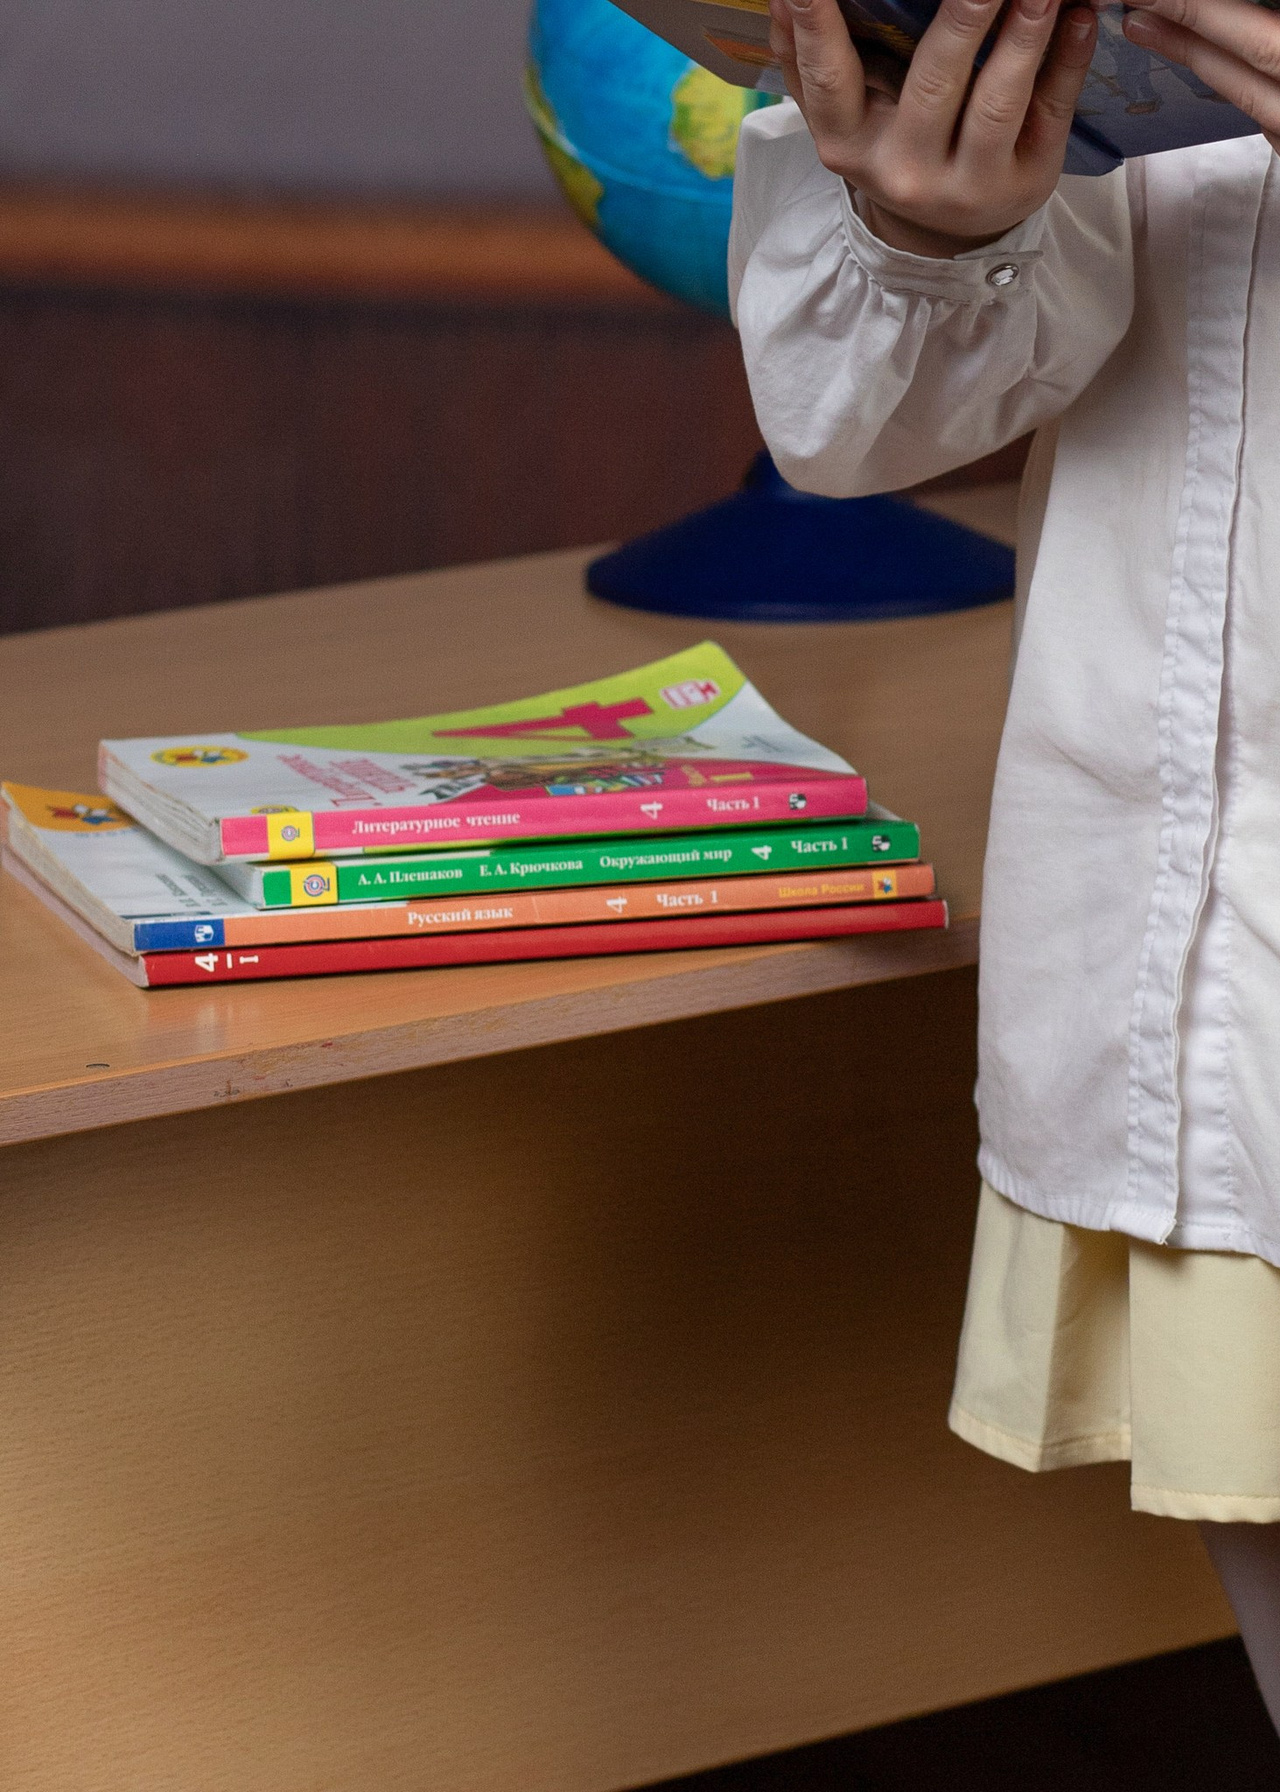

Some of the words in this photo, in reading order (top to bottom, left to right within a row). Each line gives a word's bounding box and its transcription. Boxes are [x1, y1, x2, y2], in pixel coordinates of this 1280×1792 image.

[352, 815, 461, 835] Литературное
[466, 812, 520, 827] чтение
[640, 801, 663, 820] 4
[706, 797, 750, 812] Часть
[752, 795, 760, 810] 1
[389, 868, 463, 884] Плешаков
[509, 859, 583, 878] Крючкова
[599, 849, 700, 869] Окружающий
[703, 848, 732, 864] мир
[751, 845, 772, 861] 4
[791, 839, 837, 854] Часть
[840, 837, 848, 850] 1
[407, 909, 471, 927] Русский
[474, 907, 513, 921] язык
[606, 896, 627, 913] 4
[657, 893, 704, 908] Часть
[710, 890, 718, 904] 1
[778, 885, 819, 899] Школа
[194, 952, 219, 973] 4
